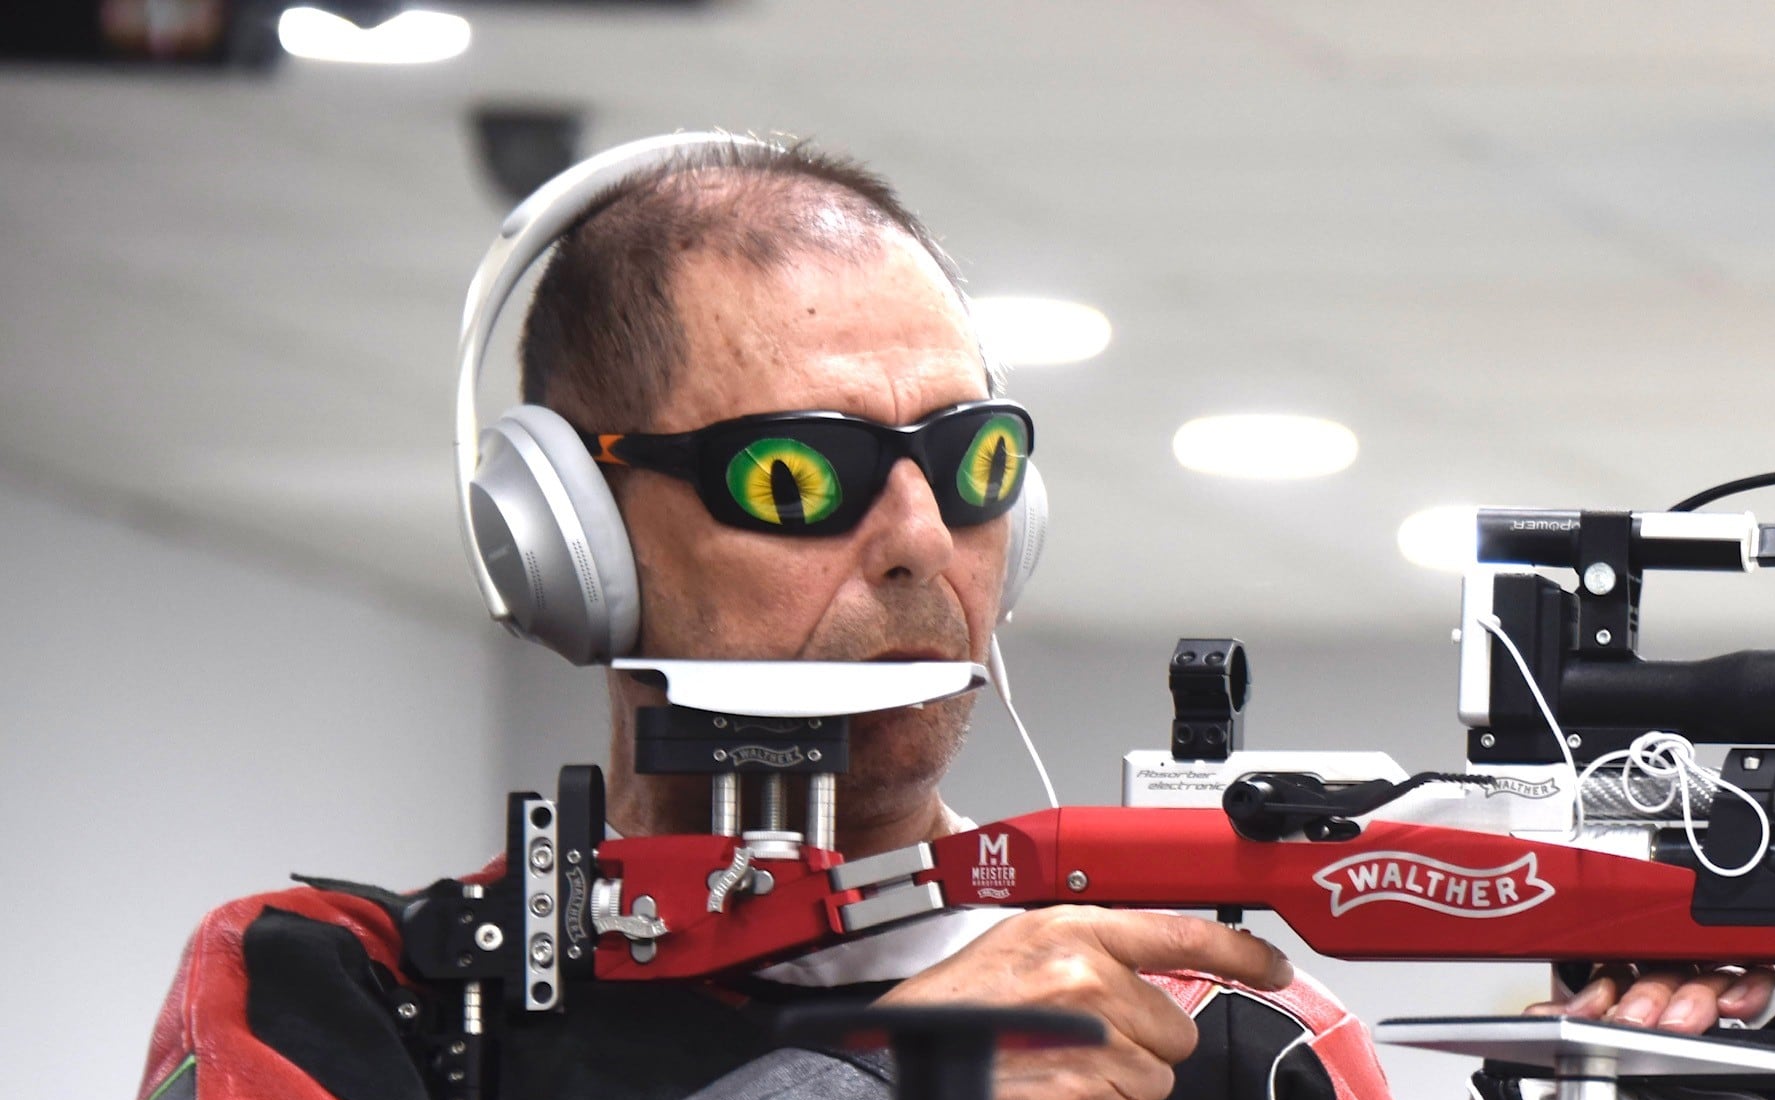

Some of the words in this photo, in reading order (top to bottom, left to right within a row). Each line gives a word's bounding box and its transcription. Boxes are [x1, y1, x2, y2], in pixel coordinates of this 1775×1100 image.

[1136, 769, 1216, 779] Absorber
[1147, 781, 1227, 791] electronic
[972, 866, 1015, 880] MEISTER
[1347, 862, 1519, 907] WALTHER
